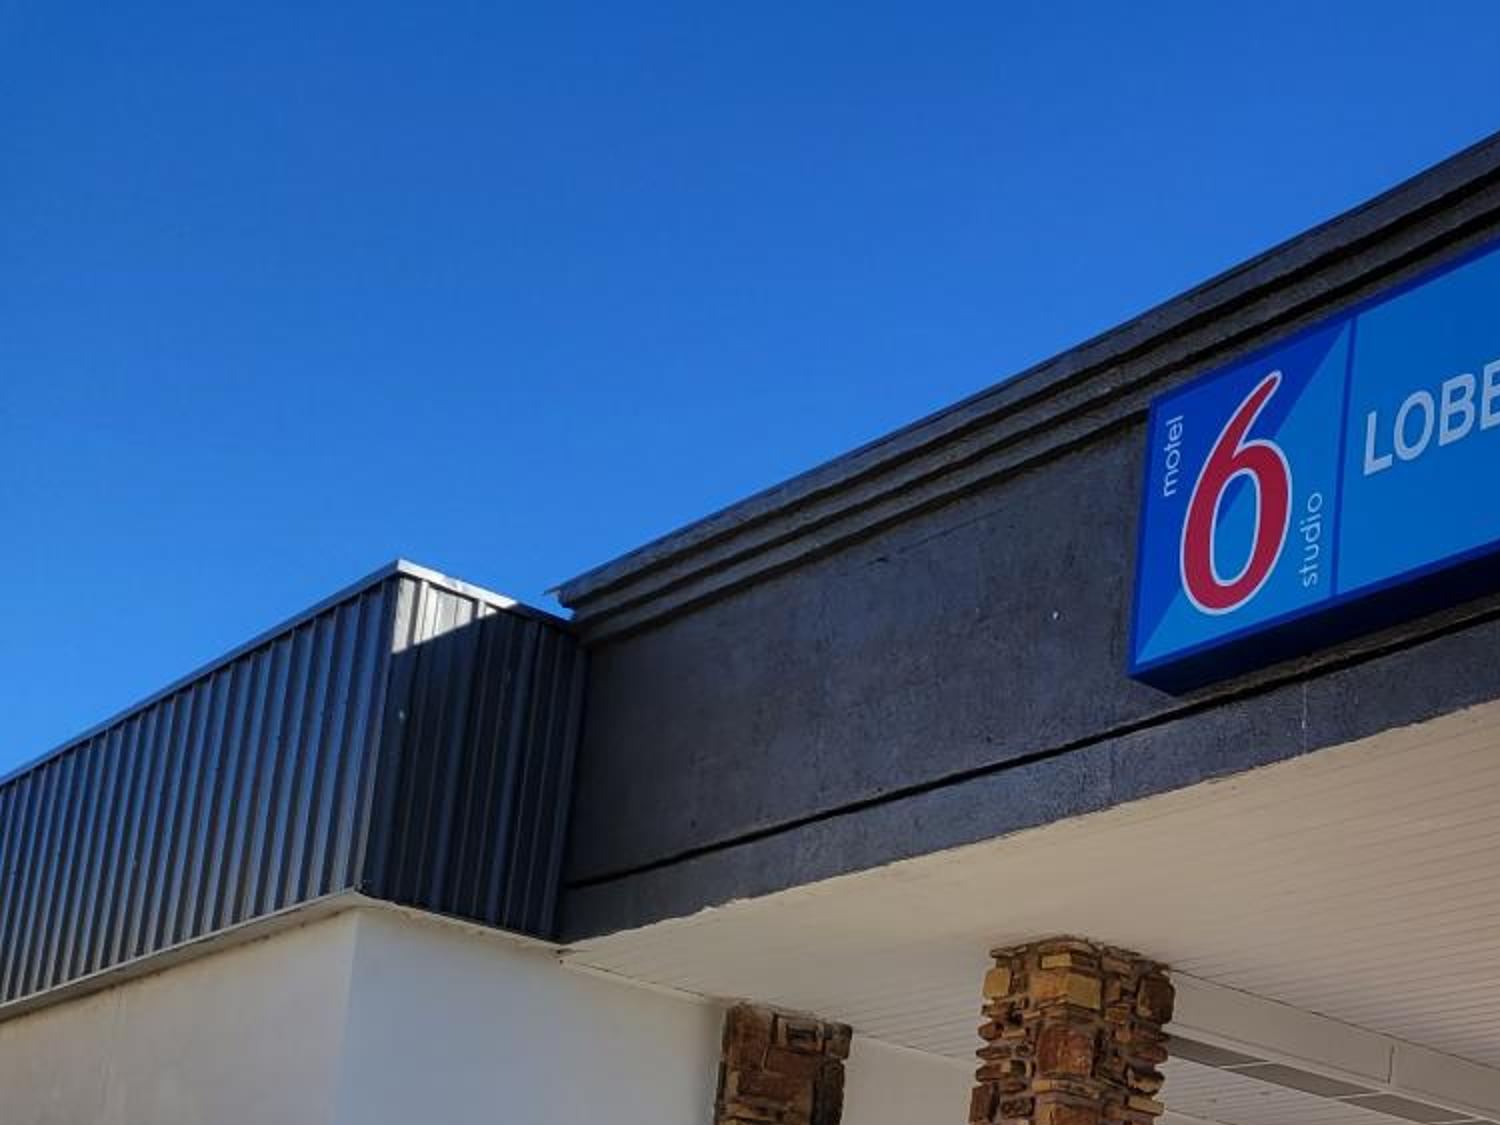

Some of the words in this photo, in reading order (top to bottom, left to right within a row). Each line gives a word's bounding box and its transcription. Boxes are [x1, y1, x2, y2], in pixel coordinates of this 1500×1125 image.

[1163, 415, 1183, 497] motel
[1181, 371, 1292, 614] 6
[1303, 493, 1323, 587] studio
